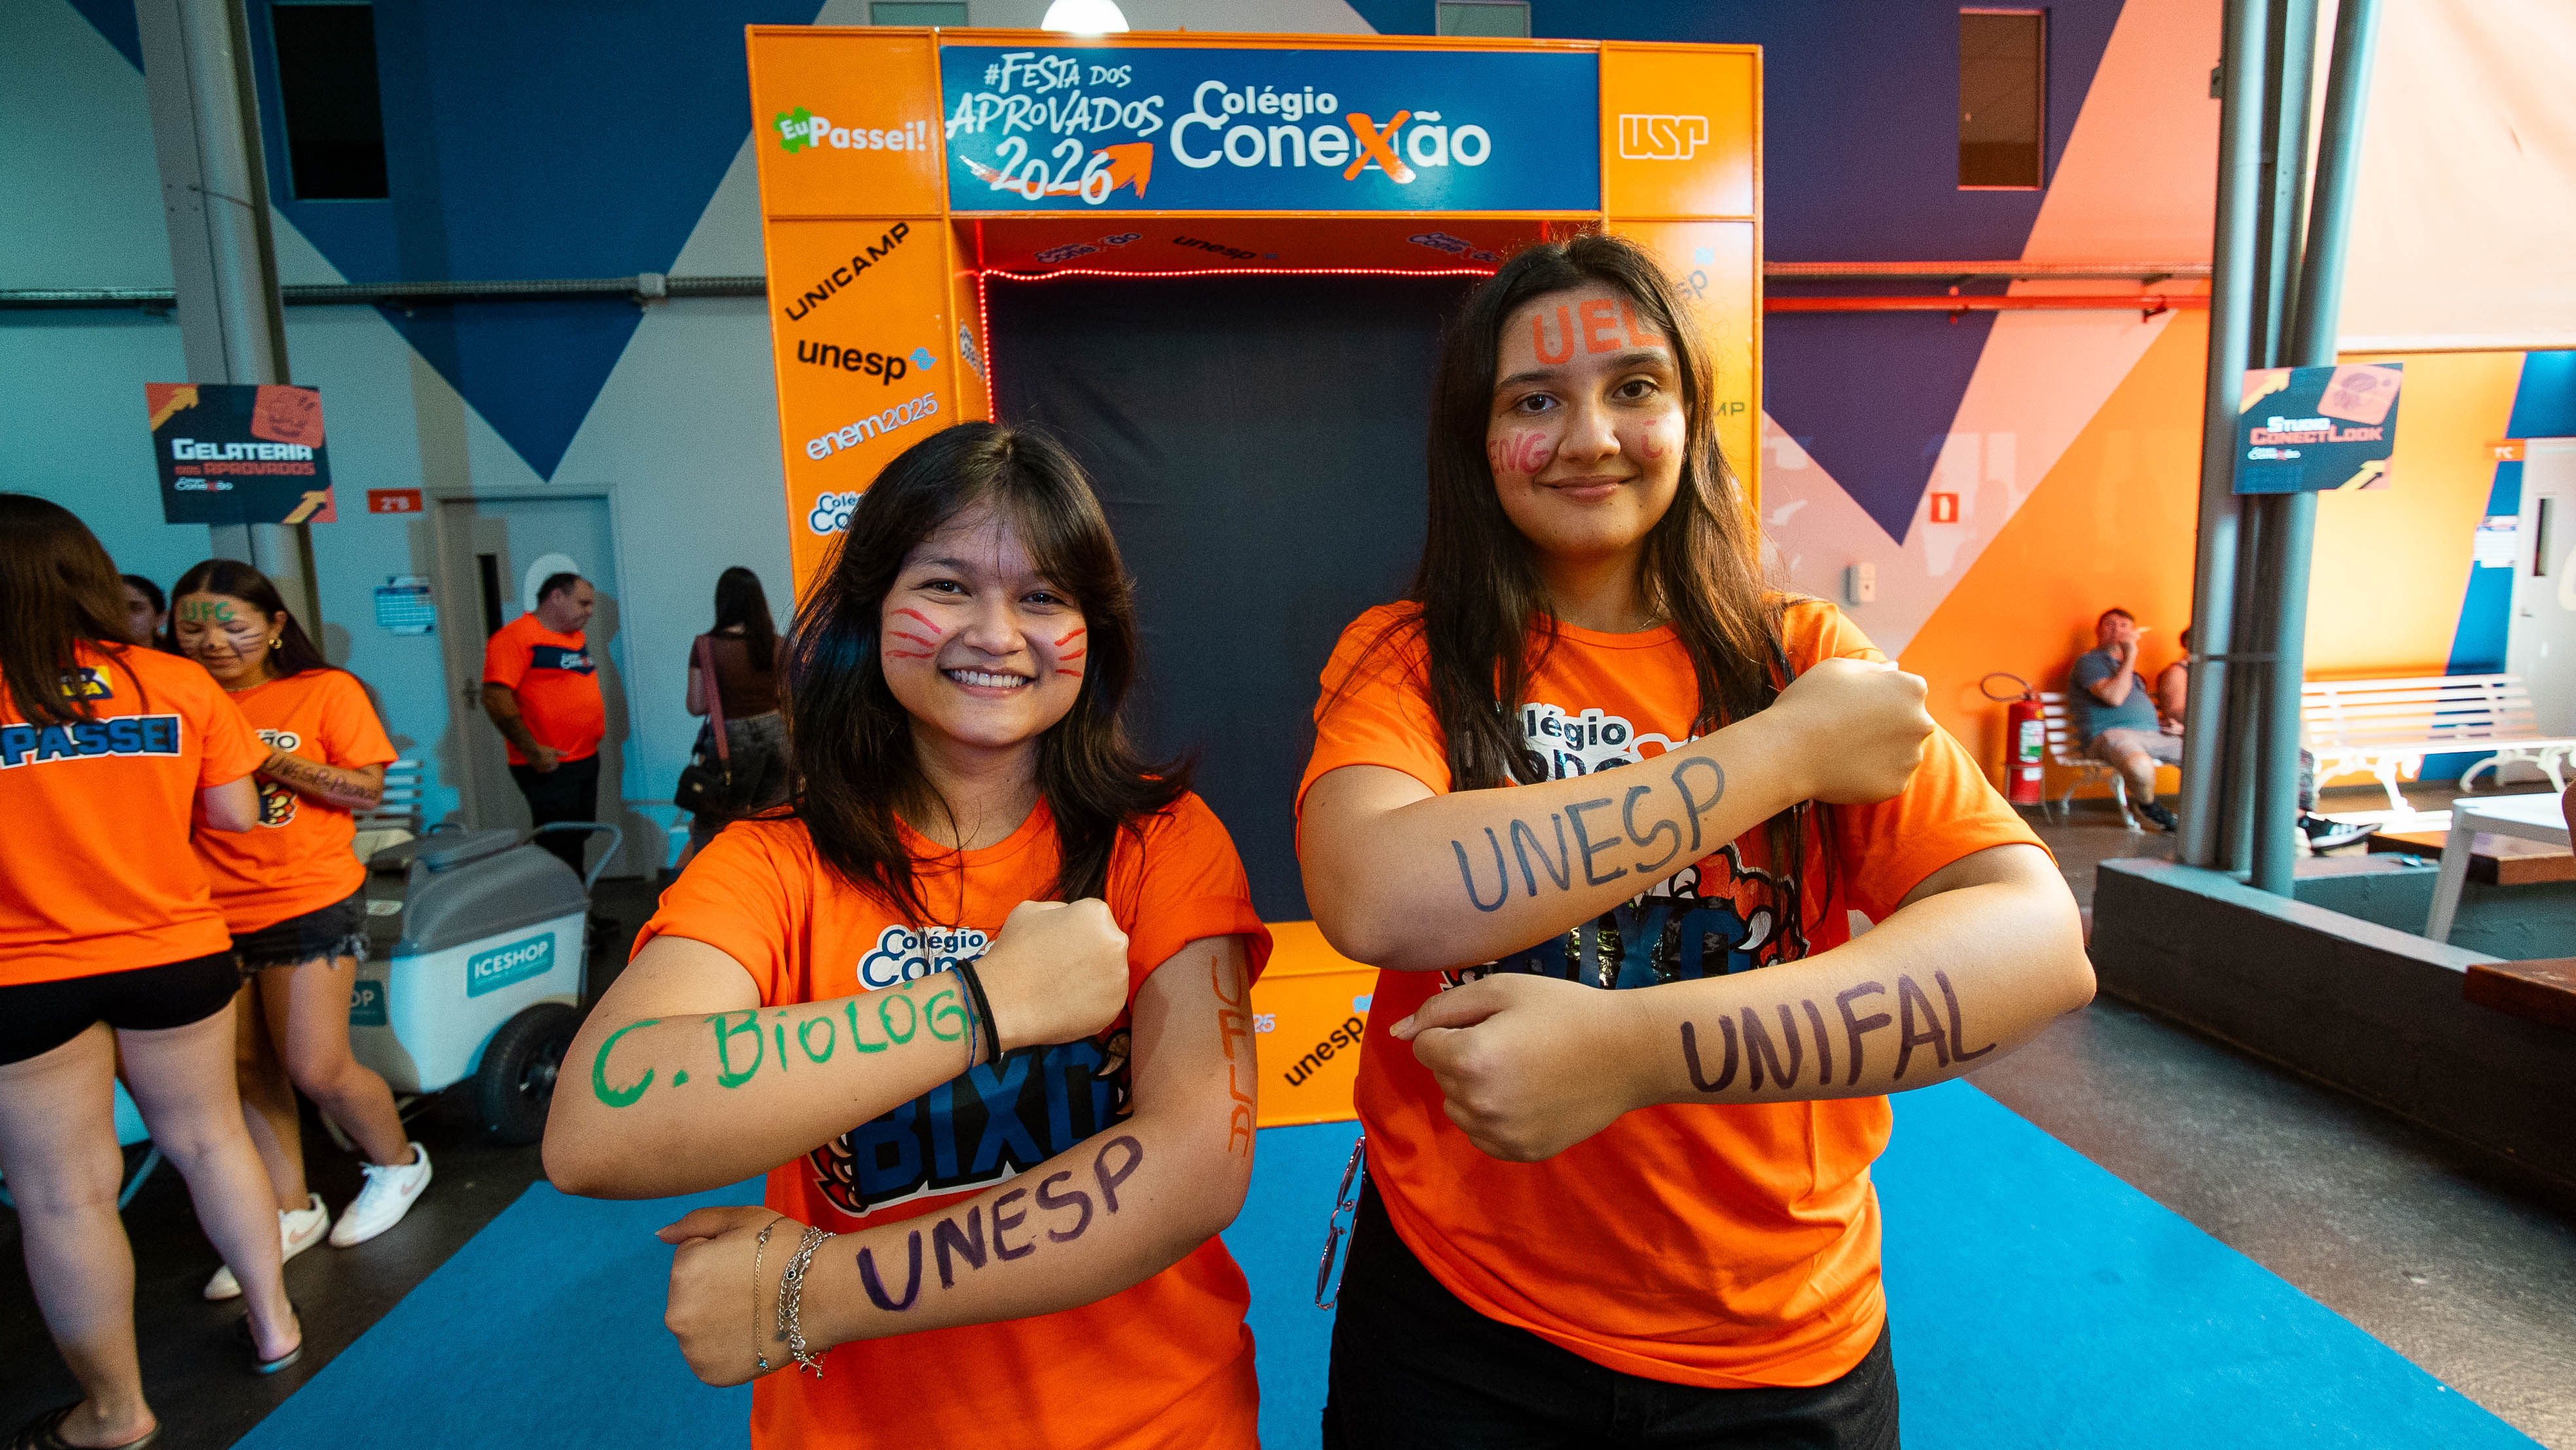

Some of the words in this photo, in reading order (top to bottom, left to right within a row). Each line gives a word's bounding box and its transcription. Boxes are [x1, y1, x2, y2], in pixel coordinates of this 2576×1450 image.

[809, 117, 925, 151] Passei!
[1194, 80, 1338, 130] Colégio
[1619, 114, 1709, 160] USP
[990, 136, 1113, 205] 2026
[785, 222, 909, 321] UNICAMP
[1173, 235, 1257, 260] unesp
[1533, 298, 1664, 364] UEL
[798, 340, 906, 385] unesp
[806, 392, 939, 460] enem2025
[1527, 710, 1626, 751] légio
[1452, 756, 1725, 912] UNESP
[474, 941, 548, 979] ICESHOP
[882, 929, 984, 961] Colégio
[1284, 1016, 1364, 1087] unesp
[1681, 970, 1997, 1093] UNIFAL
[856, 1135, 1143, 1311] UNESP
